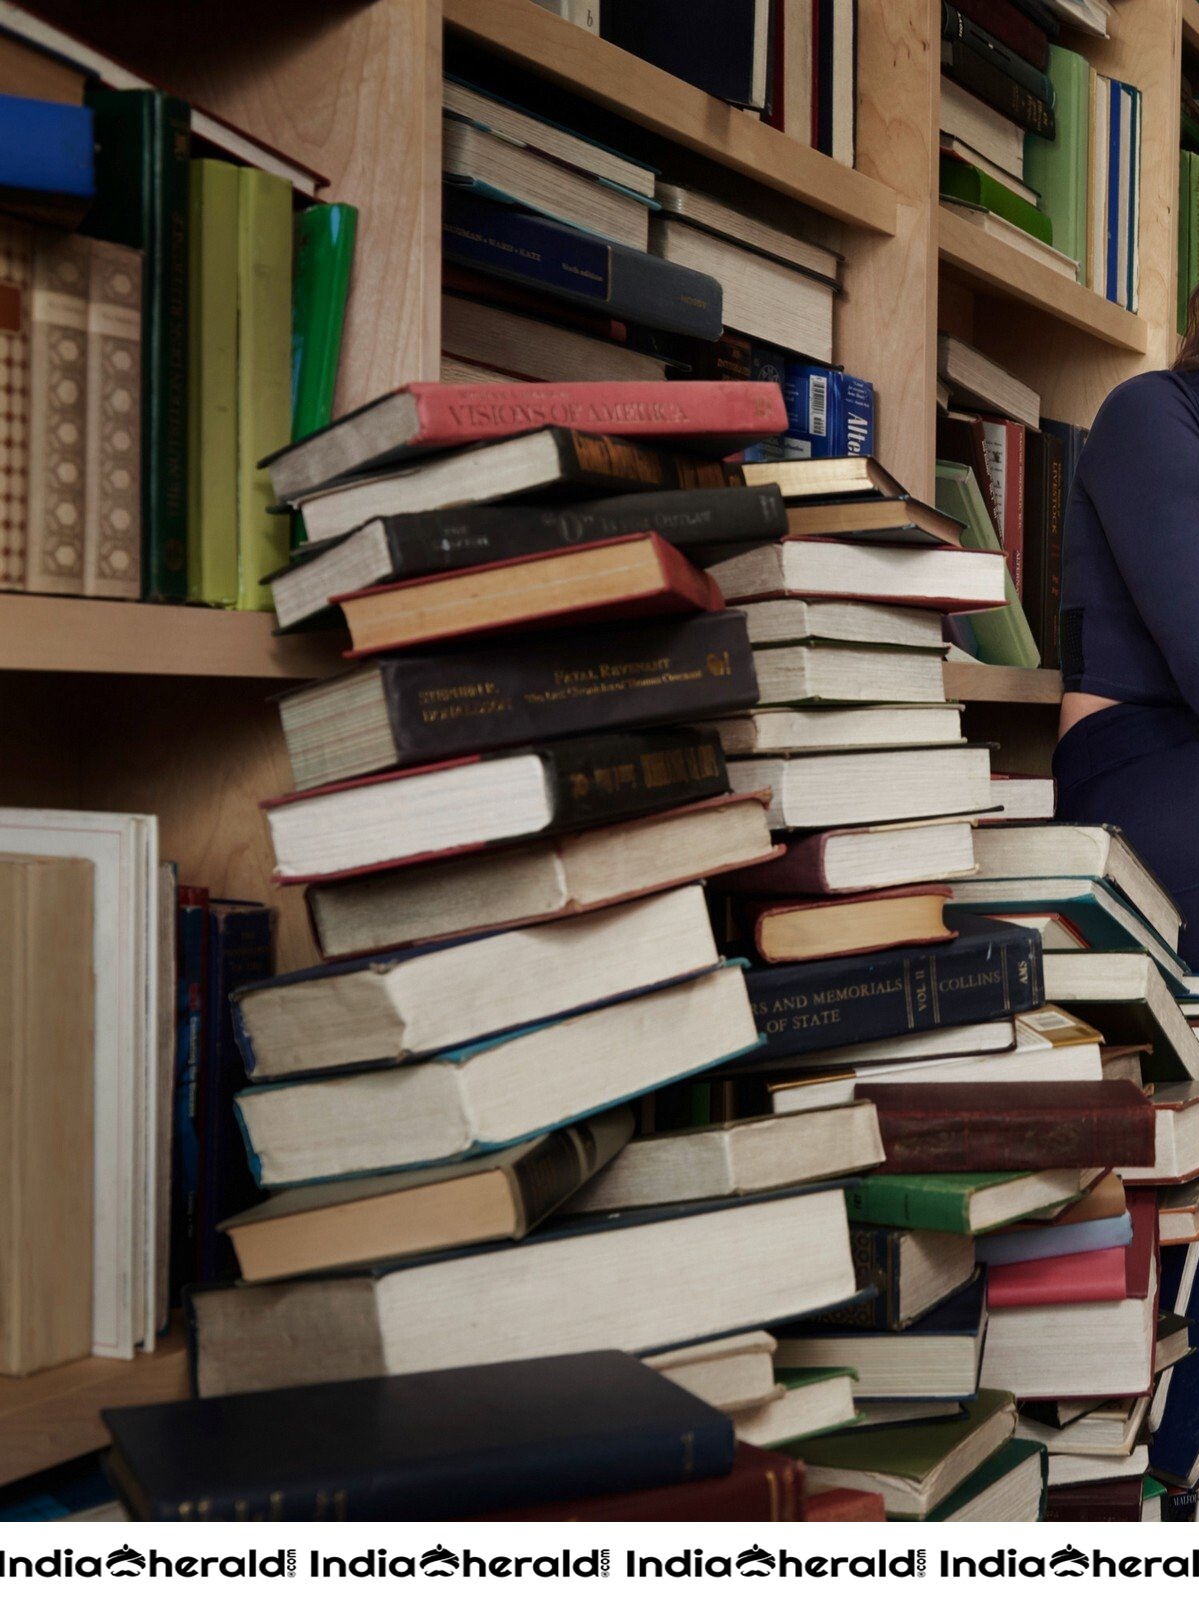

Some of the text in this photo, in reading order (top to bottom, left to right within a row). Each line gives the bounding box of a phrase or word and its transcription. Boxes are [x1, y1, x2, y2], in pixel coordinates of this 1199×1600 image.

[448, 402, 688, 429] VISIONS OF AMERICA
[1051, 461, 1059, 534] LIVESTOCK
[938, 969, 1003, 994] COLLINS
[1018, 959, 1030, 985] AMS
[773, 993, 809, 1013] AND
[811, 977, 904, 1008] MEMORIALS
[766, 1013, 790, 1033] OF
[790, 1006, 842, 1029] STATE
